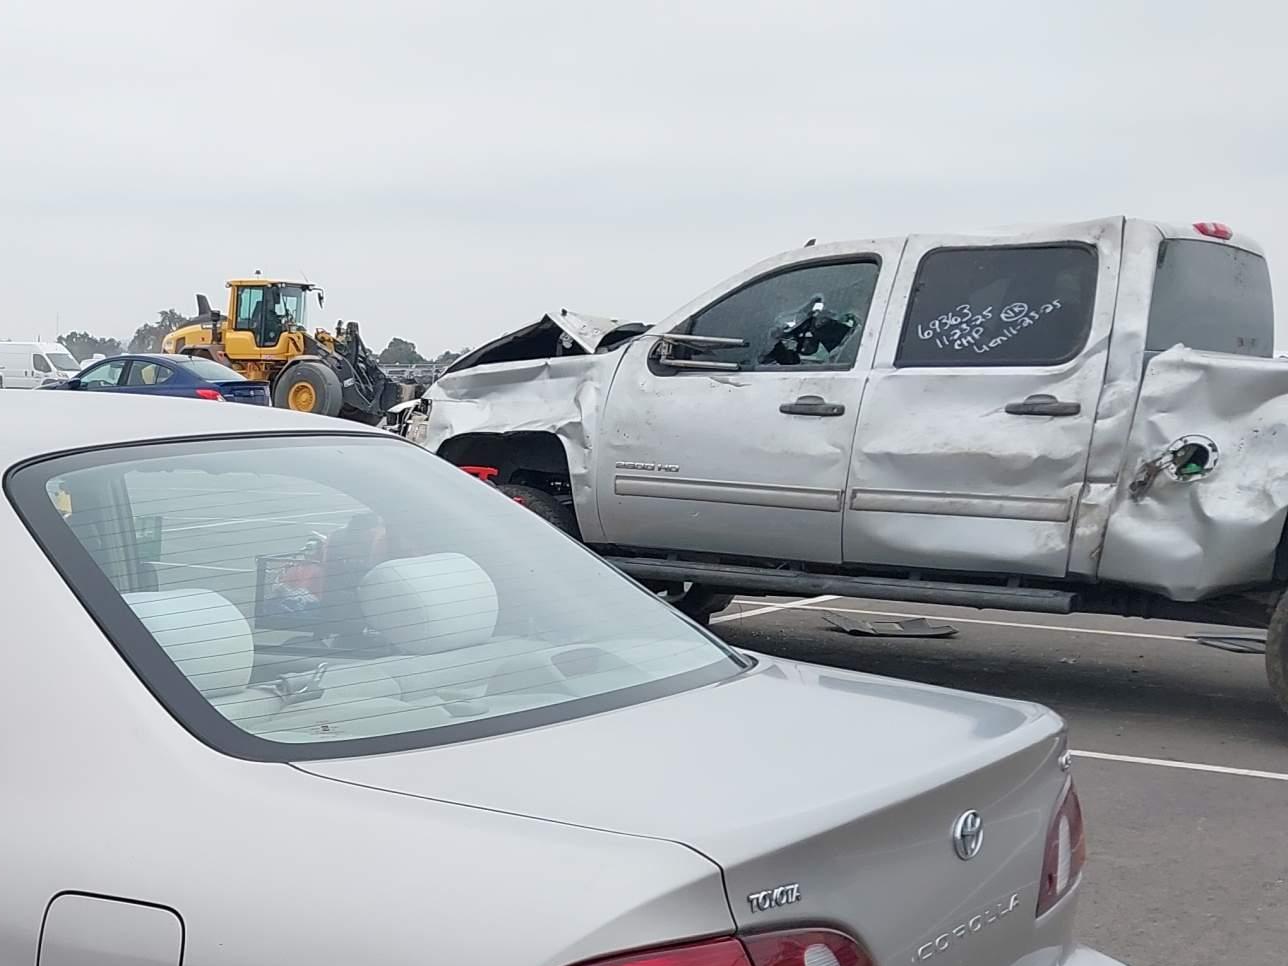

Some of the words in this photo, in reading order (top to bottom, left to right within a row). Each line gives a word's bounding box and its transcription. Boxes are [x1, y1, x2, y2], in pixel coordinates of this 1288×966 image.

[918, 304, 972, 339] 69363
[747, 883, 801, 913] TOYOTA
[917, 893, 1020, 960] COROLLA
